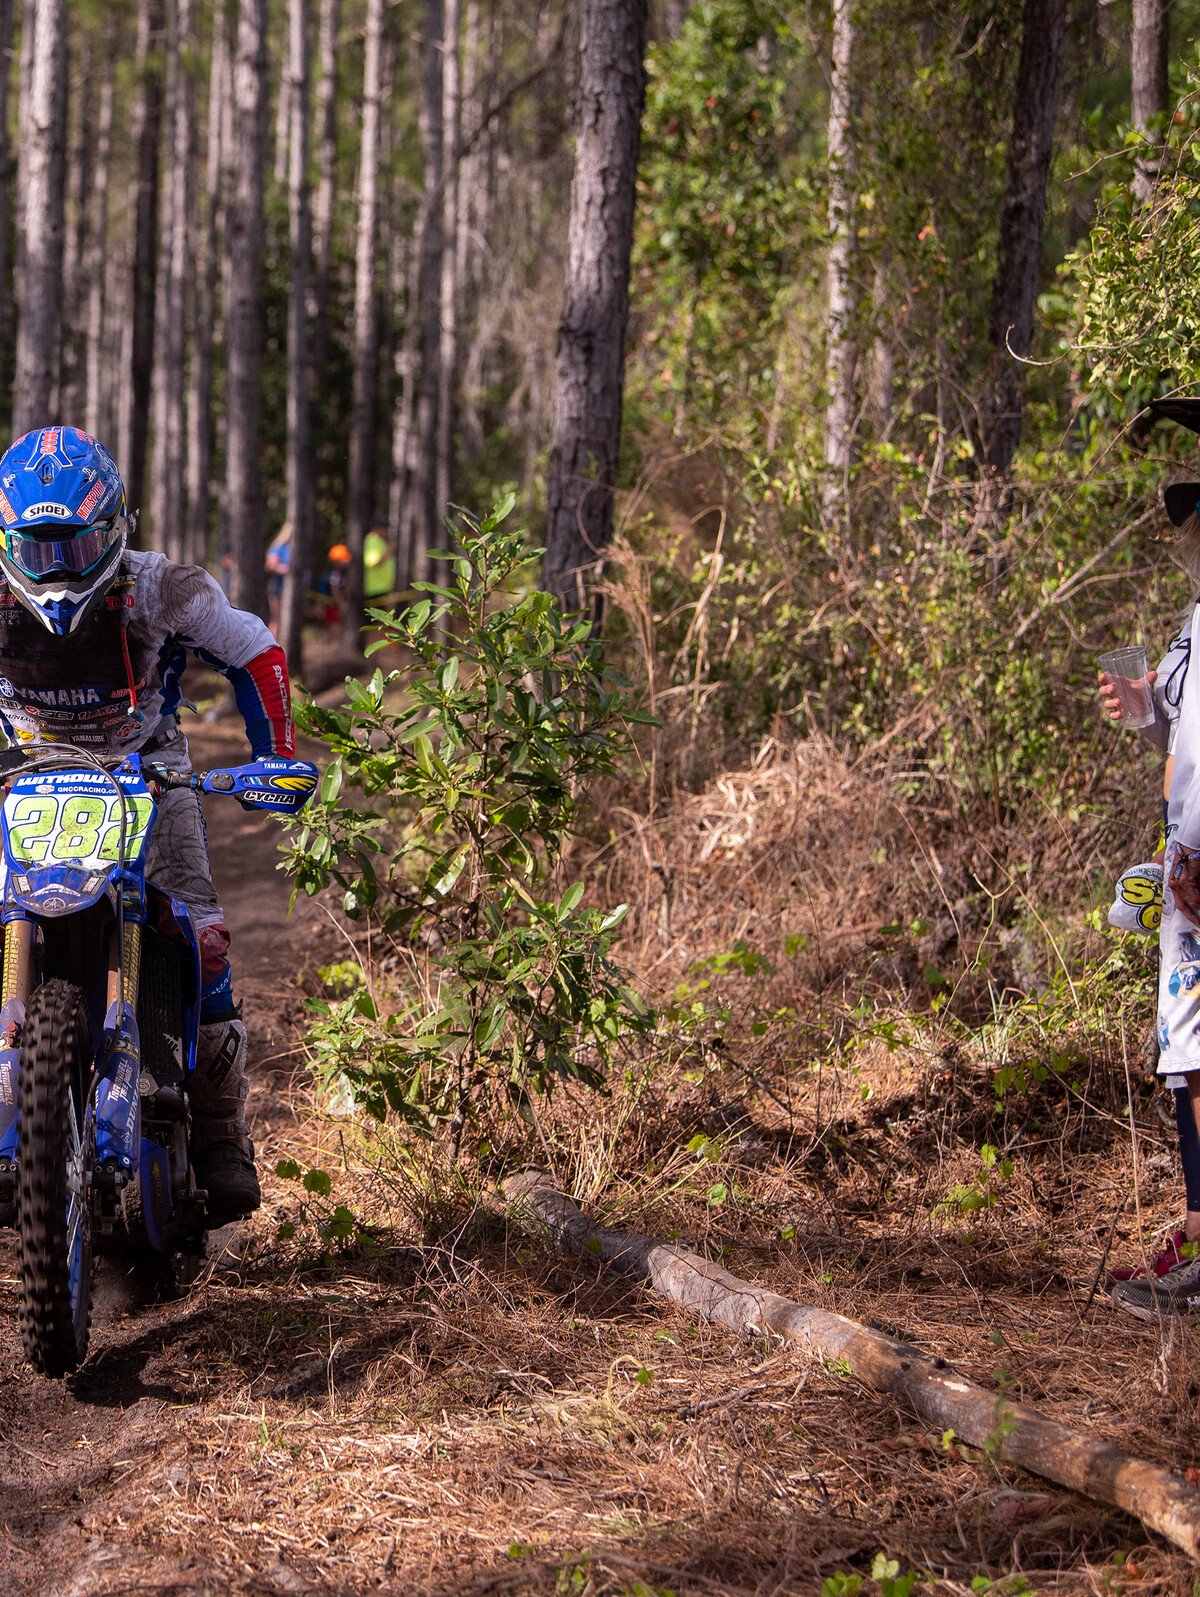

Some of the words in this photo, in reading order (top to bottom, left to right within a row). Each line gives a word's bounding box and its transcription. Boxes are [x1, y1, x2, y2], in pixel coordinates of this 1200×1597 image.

[29, 505, 65, 517] SHOEI
[13, 687, 101, 706] YAMAHA
[71, 735, 105, 743] YAMALUBE
[263, 762, 287, 770] YAMAHA
[244, 791, 295, 805] CYCRA
[9, 795, 154, 861] 282
